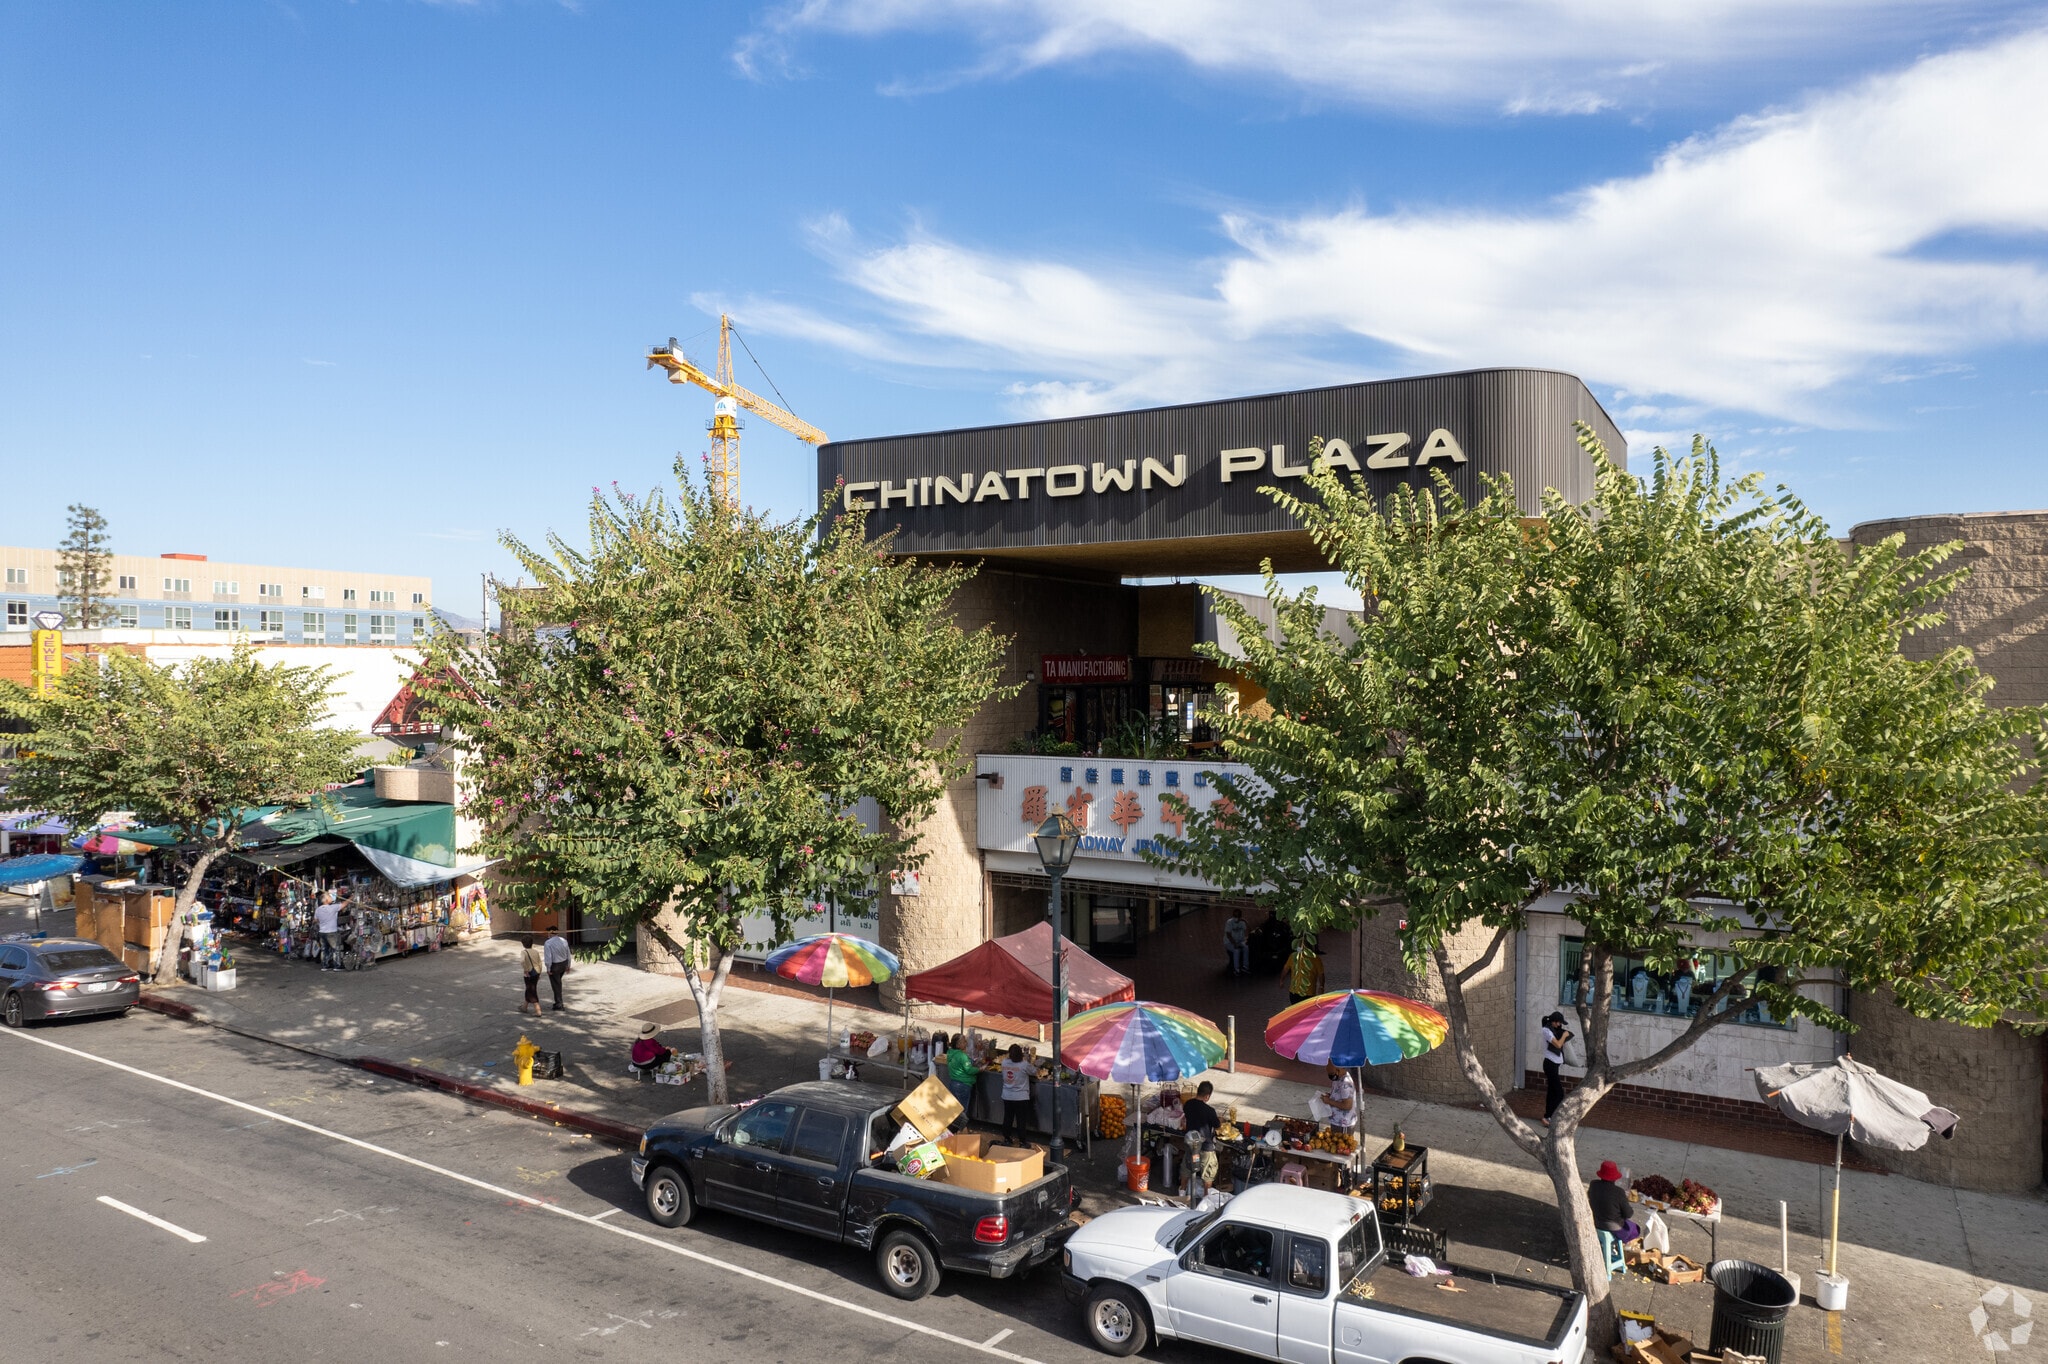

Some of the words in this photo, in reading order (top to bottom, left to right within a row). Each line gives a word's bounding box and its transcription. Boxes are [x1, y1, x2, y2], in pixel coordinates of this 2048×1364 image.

[844, 454, 1186, 511] CHINATOWN
[1220, 428, 1468, 483] PLAZA
[1045, 661, 1056, 677] TA
[1058, 660, 1126, 677] MANUFACTURING
